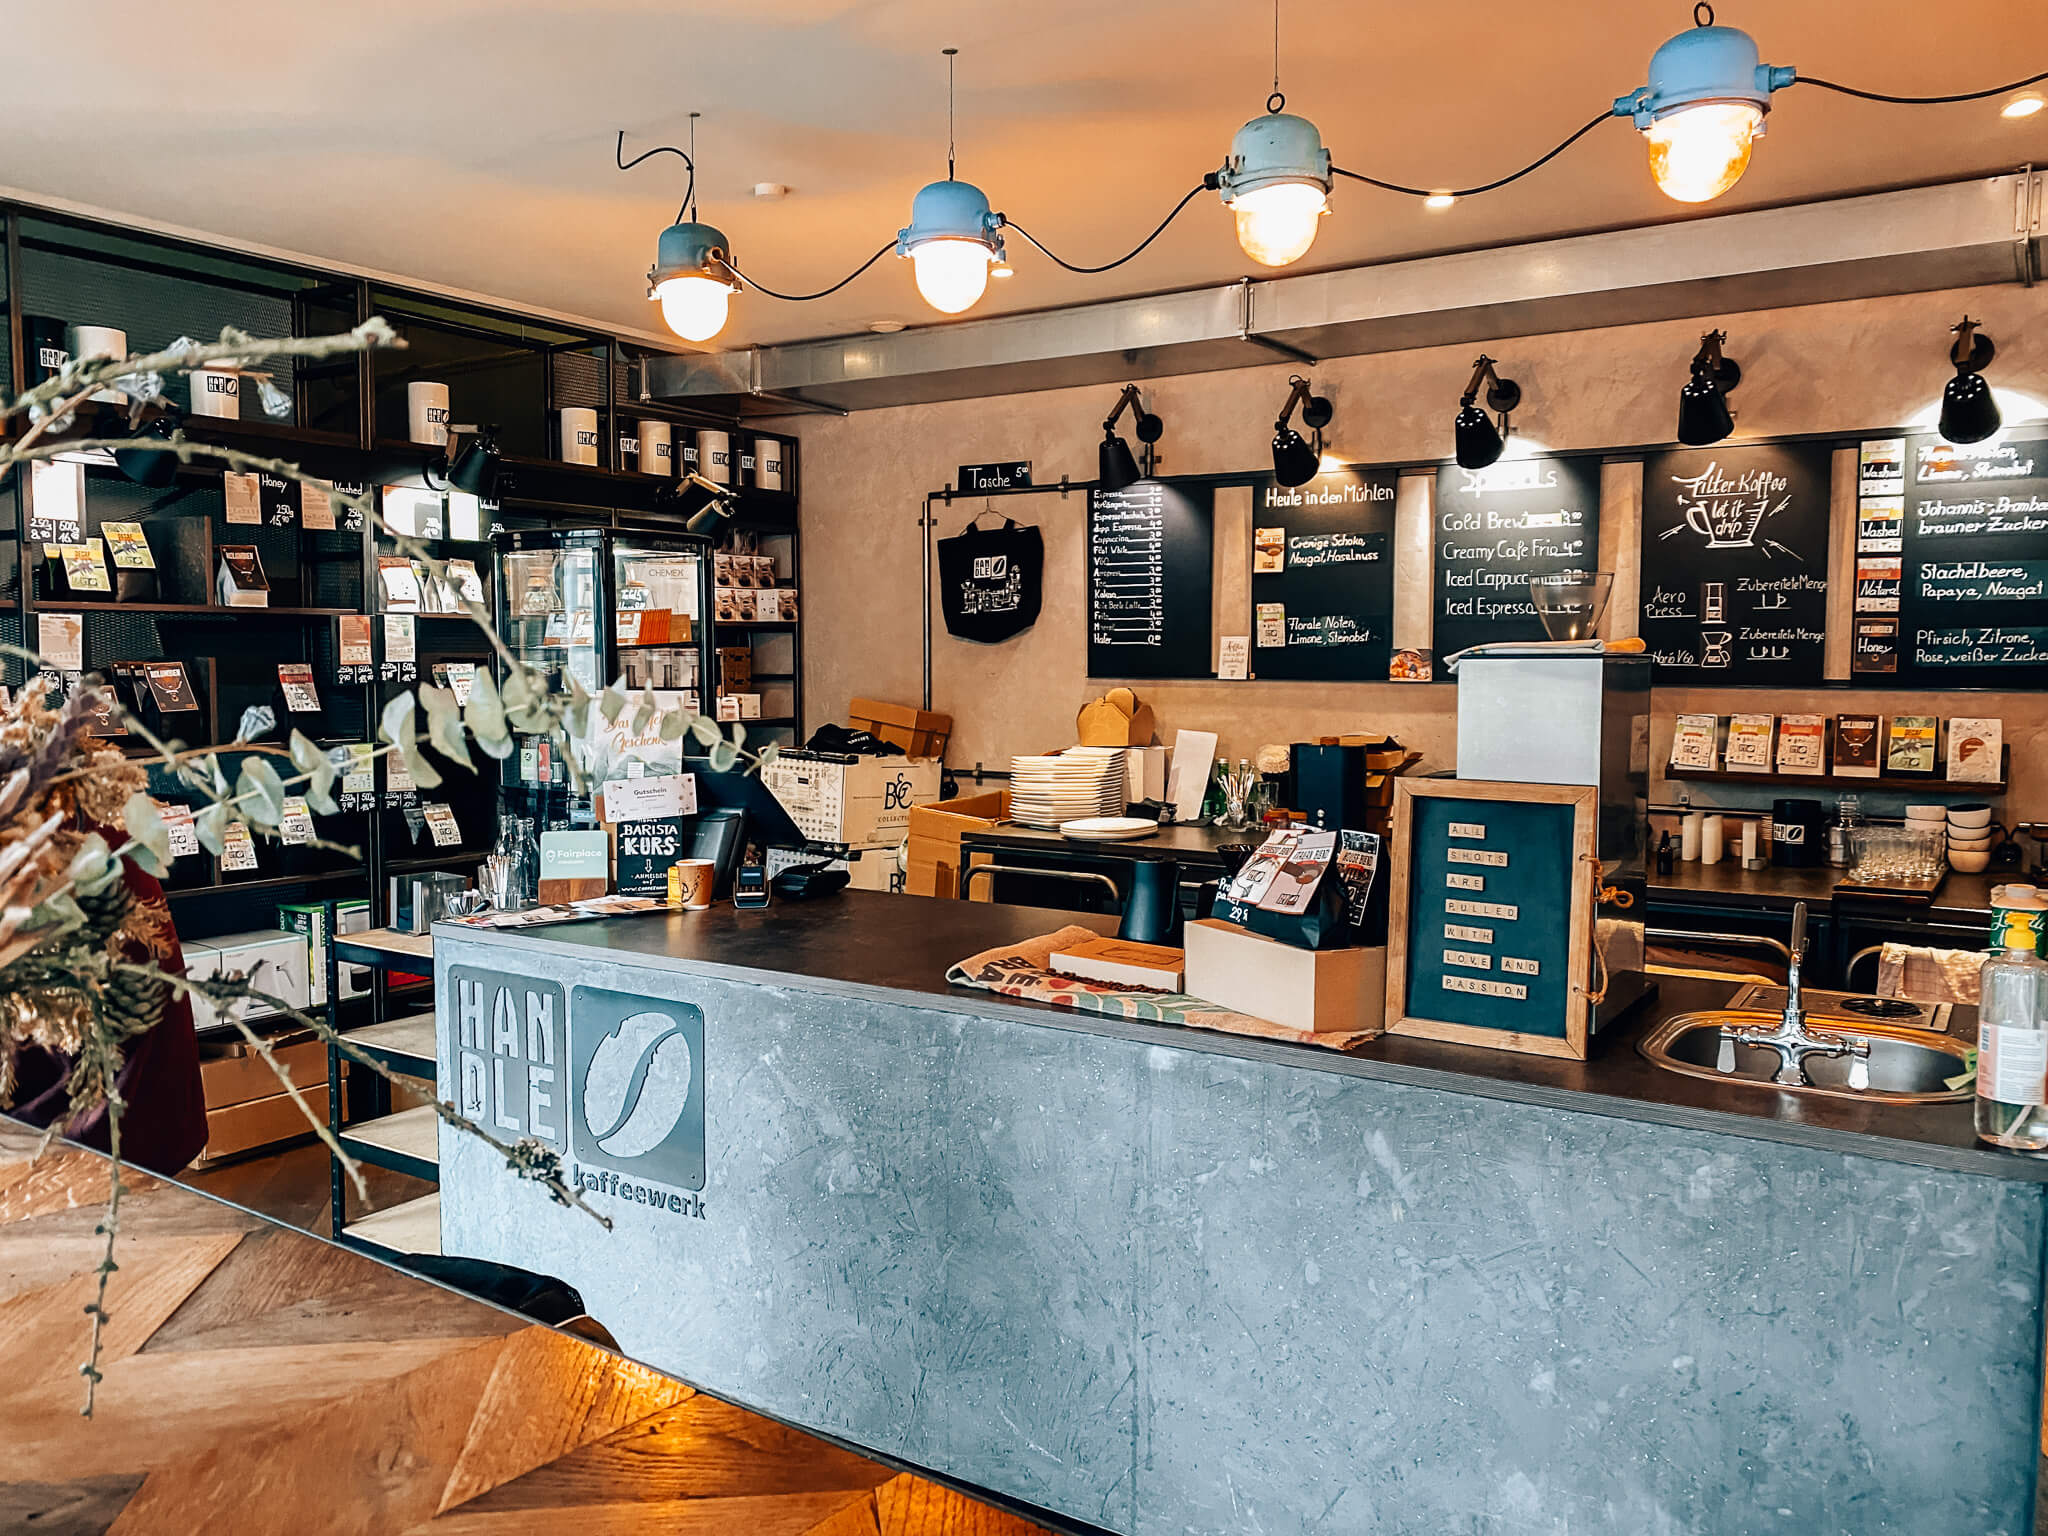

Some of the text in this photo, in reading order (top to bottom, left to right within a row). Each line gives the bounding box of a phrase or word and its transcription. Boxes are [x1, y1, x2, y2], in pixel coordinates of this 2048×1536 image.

[261, 474, 287, 493] Honey
[967, 466, 1011, 489] Tasche
[1266, 483, 1394, 508] Heute in den Mühlen
[1711, 502, 1745, 518] let it
[1443, 511, 1481, 531] Cold
[1715, 518, 1743, 538] drip
[1861, 520, 1902, 537] Washed
[1919, 519, 1986, 535] brauner
[1289, 549, 1379, 567] Nougat, Haselnuss
[1443, 541, 1495, 562] Creamy
[1532, 538, 1558, 557] Frio
[975, 559, 990, 568] HAN
[1920, 562, 2028, 580] Stachelbeere,
[648, 568, 685, 577] CHEMEX
[975, 568, 990, 577] DLE
[1446, 569, 1473, 587] Iced
[1652, 584, 1686, 604] Aero
[1860, 580, 1901, 596] Natural
[1922, 580, 2043, 600] Papaya, Nougat
[1446, 598, 1473, 615] Iced
[1476, 598, 1535, 620] Espresso
[1644, 603, 1683, 617] Press
[1288, 616, 1321, 631] Florale
[1288, 629, 1370, 645] Limone, Steinobst
[1916, 628, 2035, 646] Pfirsich, Zitrone,
[1858, 638, 1893, 654] Honey
[1677, 649, 1694, 665] V60
[1916, 649, 1949, 664] Rose,
[1949, 647, 1999, 661] weißer
[633, 787, 667, 796] Gutschein
[621, 824, 678, 837] BARISTA
[1451, 826, 1482, 837] ALL
[557, 849, 602, 859] Fairplace
[623, 836, 677, 856] KURS
[1450, 851, 1505, 864] SHOTS
[1449, 877, 1481, 889] ARE
[1448, 902, 1515, 918] PULLED
[1447, 927, 1491, 941] WITH
[1446, 952, 1537, 973] LOVE AND
[1445, 978, 1524, 997] PASSION
[458, 978, 554, 1065] HAN
[460, 1050, 556, 1140] DLE
[572, 1163, 706, 1220] kaffeewerk
